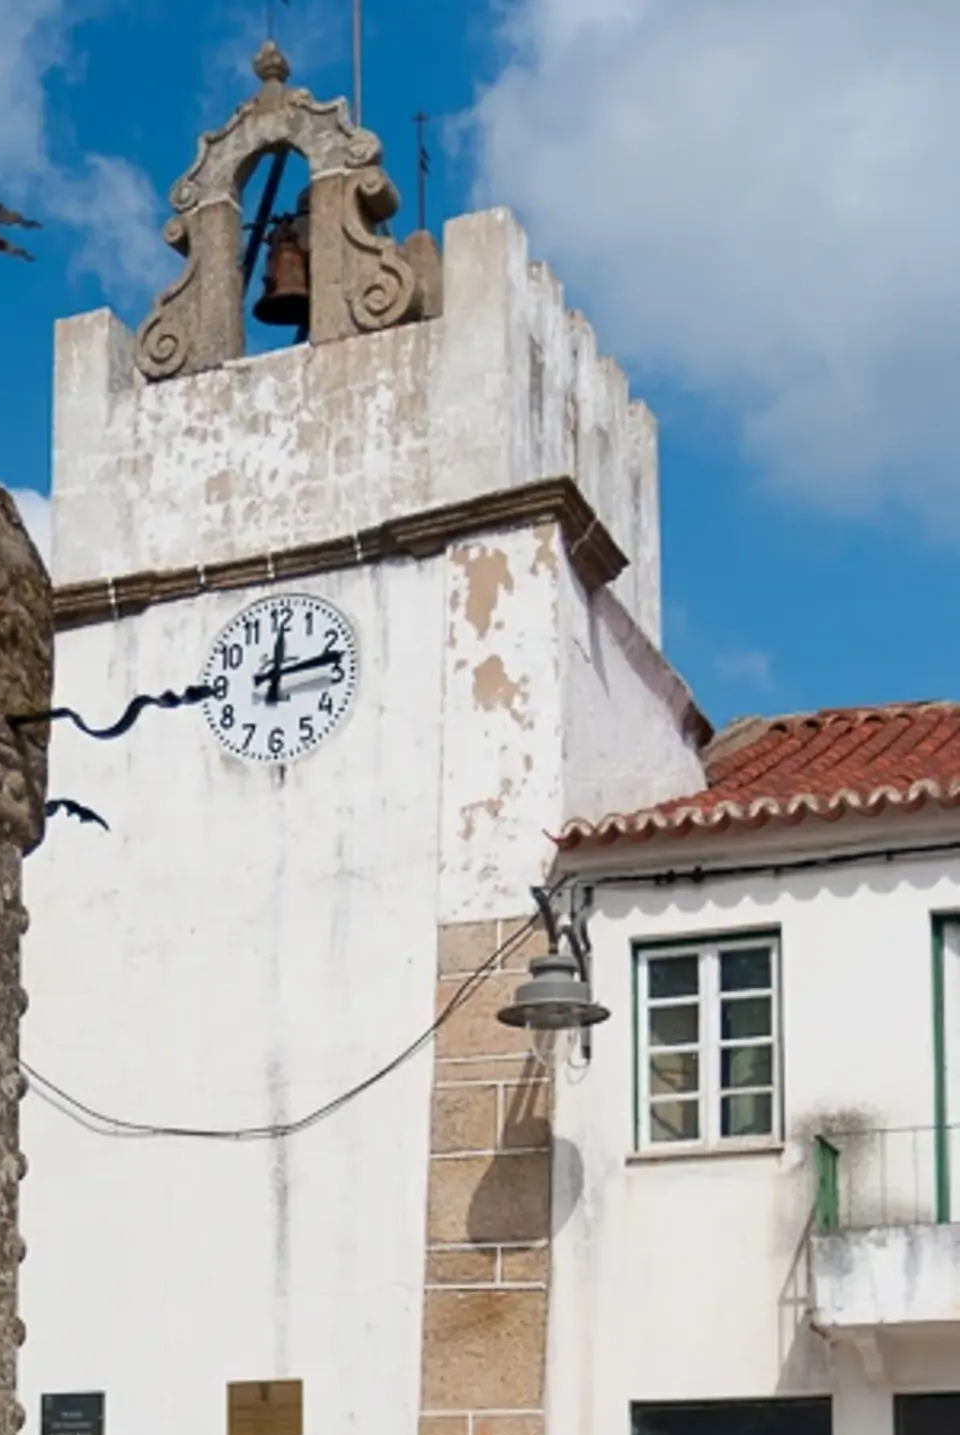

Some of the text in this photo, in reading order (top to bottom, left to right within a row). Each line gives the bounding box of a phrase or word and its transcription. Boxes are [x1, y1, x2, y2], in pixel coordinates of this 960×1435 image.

[245, 620, 260, 645] 11
[270, 608, 293, 632] 12
[305, 612, 314, 636] 1
[324, 630, 339, 653] 2
[222, 644, 243, 670] 10
[331, 659, 345, 684] 3
[318, 692, 333, 715] 4
[220, 704, 235, 729] 8
[242, 723, 257, 750] 7
[268, 728, 285, 753] 6
[299, 717, 314, 742] 5
